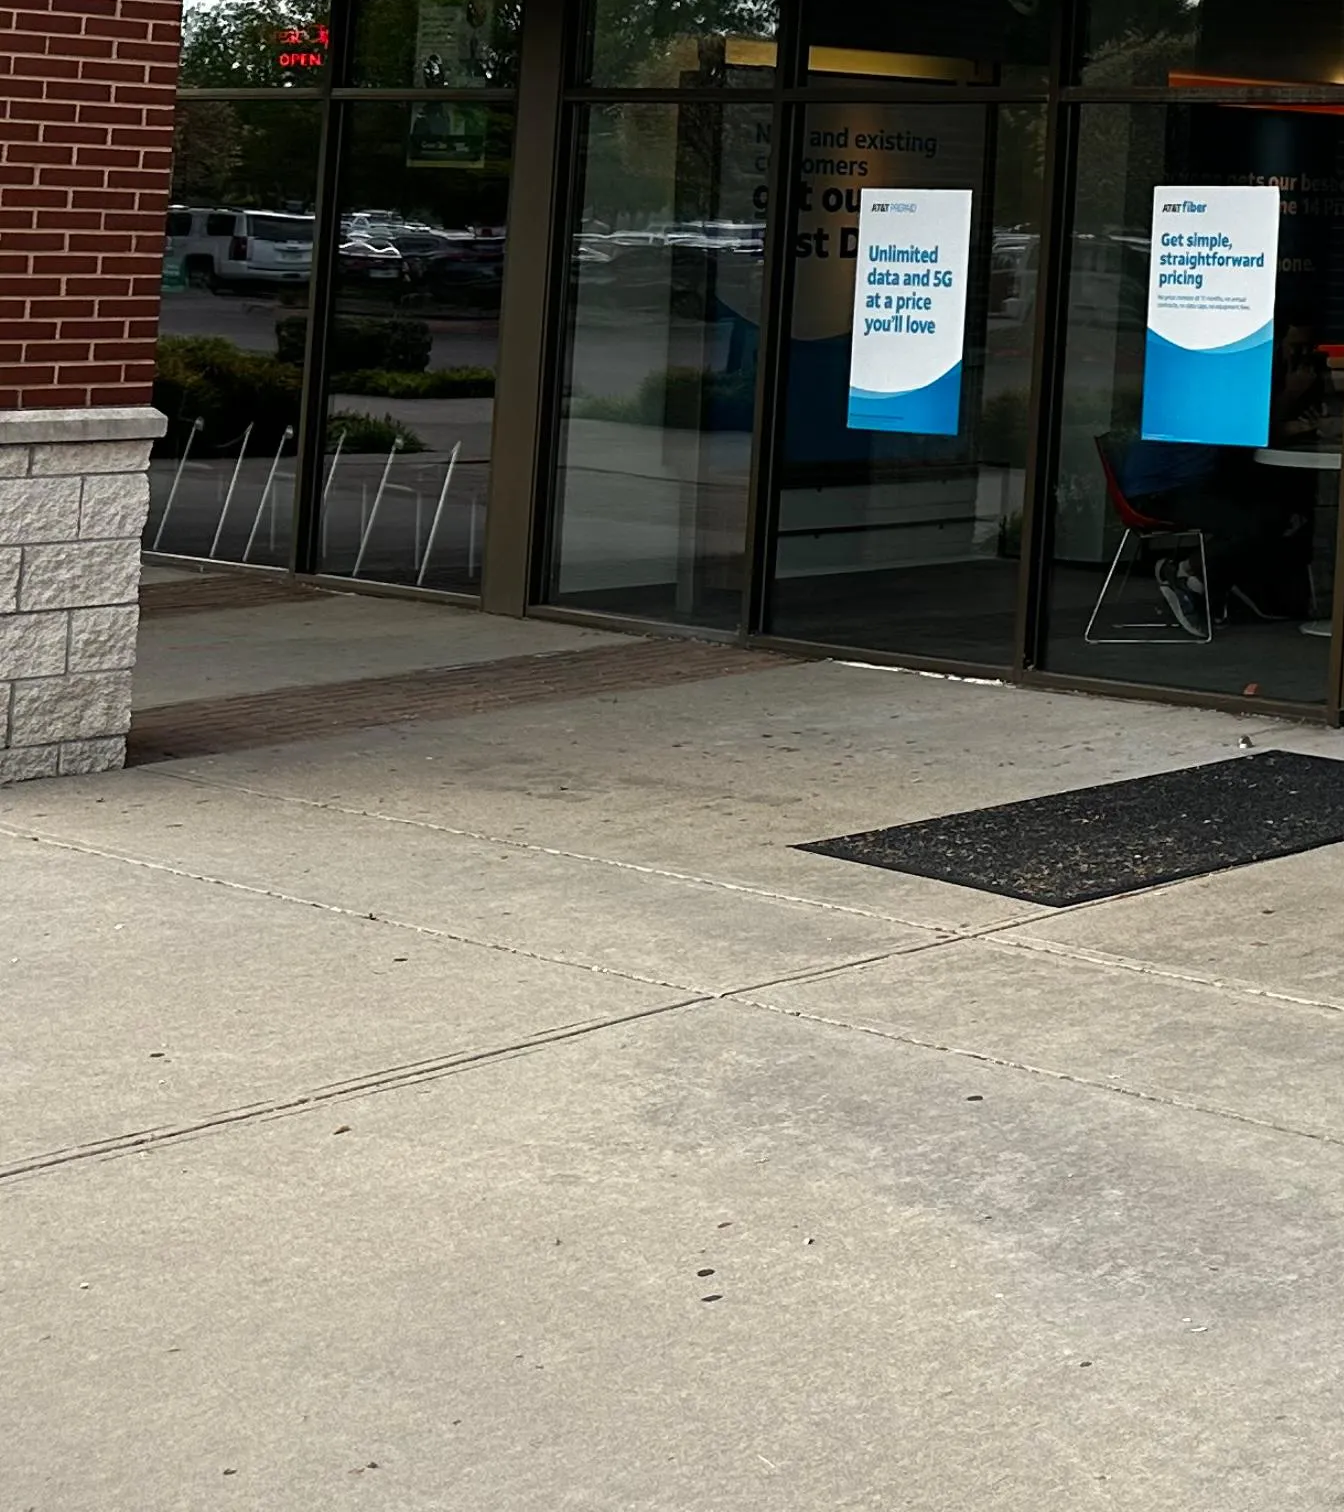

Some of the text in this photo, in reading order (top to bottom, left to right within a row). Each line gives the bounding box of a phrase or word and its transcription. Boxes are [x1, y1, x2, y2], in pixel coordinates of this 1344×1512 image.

[279, 52, 322, 67] OPEN
[810, 127, 938, 157] and existing
[822, 187, 861, 213] ou
[871, 202, 890, 213] AT&T
[1162, 200, 1208, 213] AT&T fiber
[1161, 232, 1233, 251] Get simple,
[869, 244, 939, 264] Unlimited
[1159, 251, 1265, 270] straightforward
[867, 267, 953, 288] data and 5G
[1159, 270, 1204, 289] pricing
[866, 291, 932, 314] at a price
[864, 314, 936, 336] you'll love
